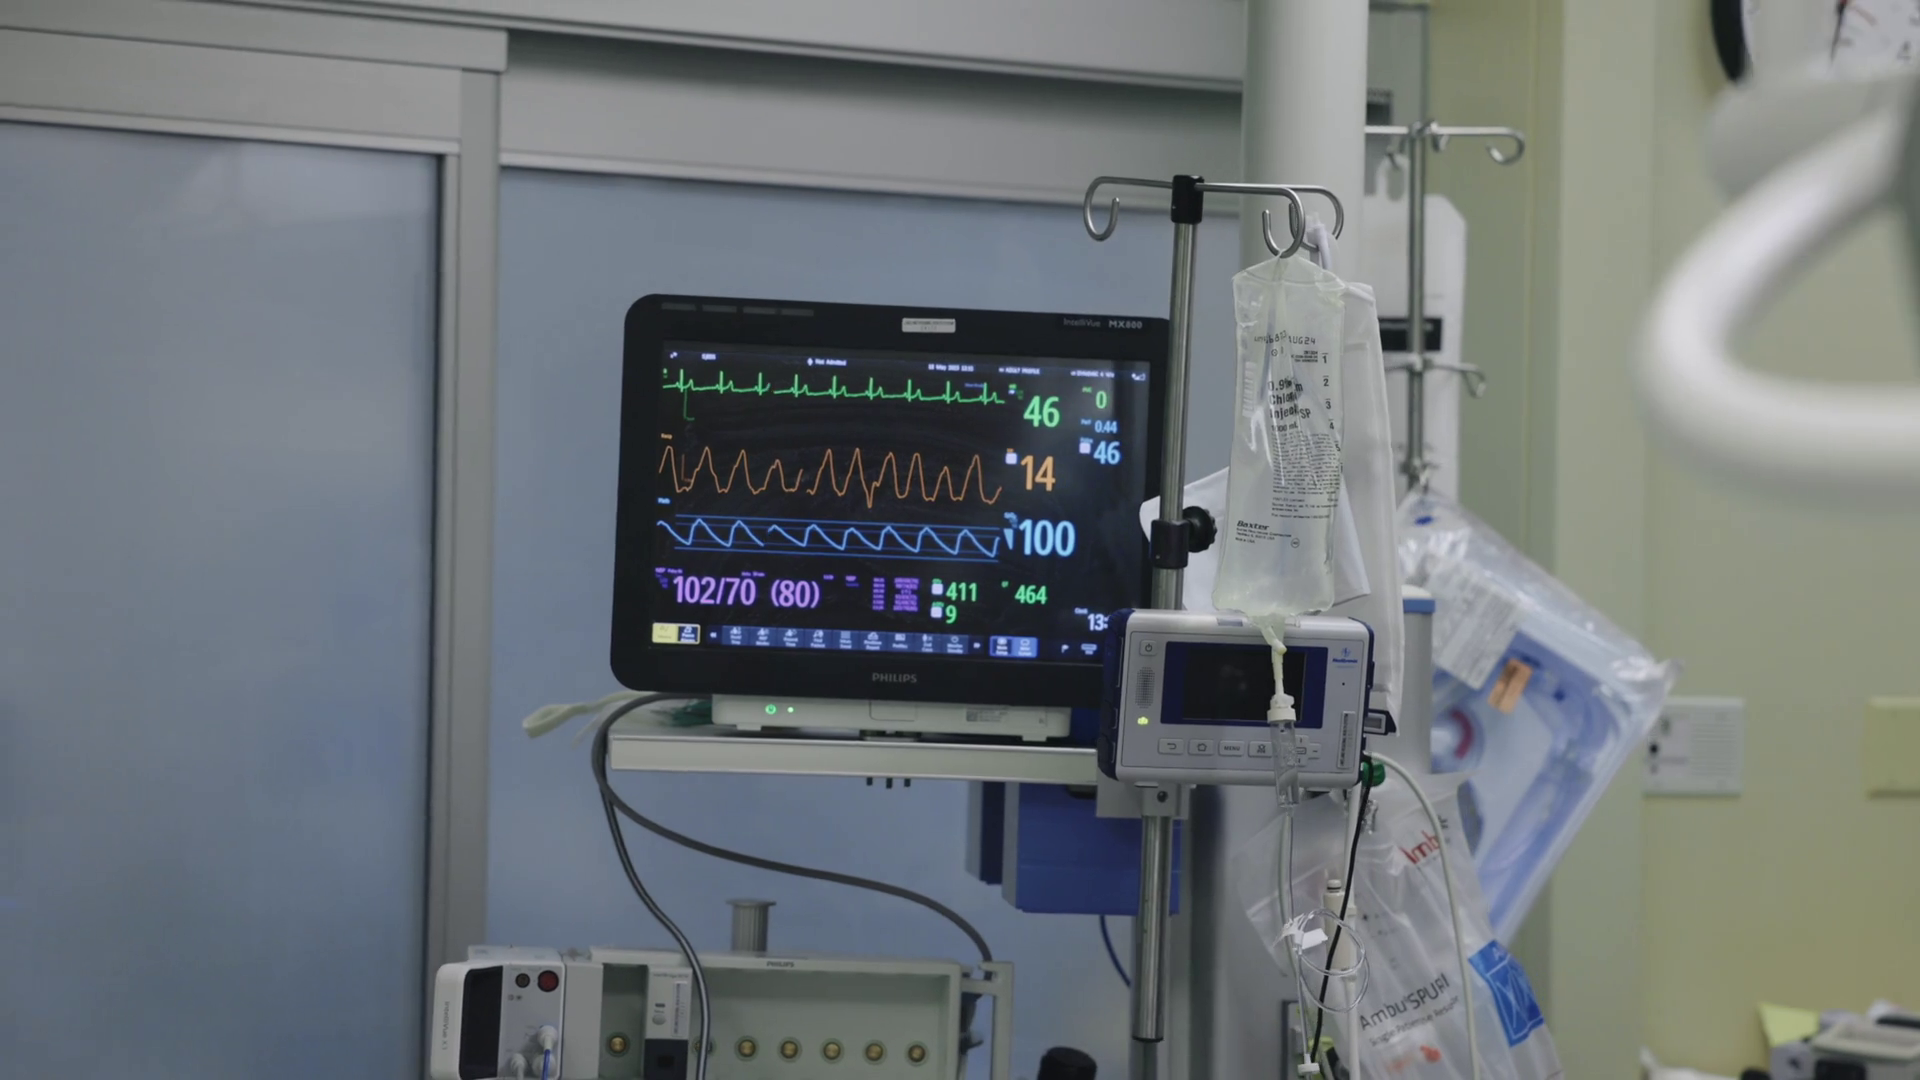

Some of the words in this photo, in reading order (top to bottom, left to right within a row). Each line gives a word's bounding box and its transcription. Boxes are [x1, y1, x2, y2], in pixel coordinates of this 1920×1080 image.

[1108, 319, 1143, 330] MX800
[1323, 378, 1330, 387] 2
[1096, 389, 1107, 409] 0
[1325, 400, 1332, 410] 3
[1023, 395, 1060, 428] 46
[1094, 420, 1117, 434] 0.44
[1329, 421, 1335, 430] 4
[1093, 441, 1120, 465] 46
[1336, 444, 1341, 452] 5
[1020, 455, 1056, 492] 14
[1237, 520, 1269, 530] Baxter
[1019, 519, 1075, 557] 100
[673, 575, 756, 606] 102/70
[771, 579, 820, 609] (80)
[946, 581, 978, 602] 411
[1014, 584, 1048, 605] 464
[945, 604, 957, 624] 9
[1087, 613, 1108, 631] 13:
[872, 672, 918, 683] PHILIPS
